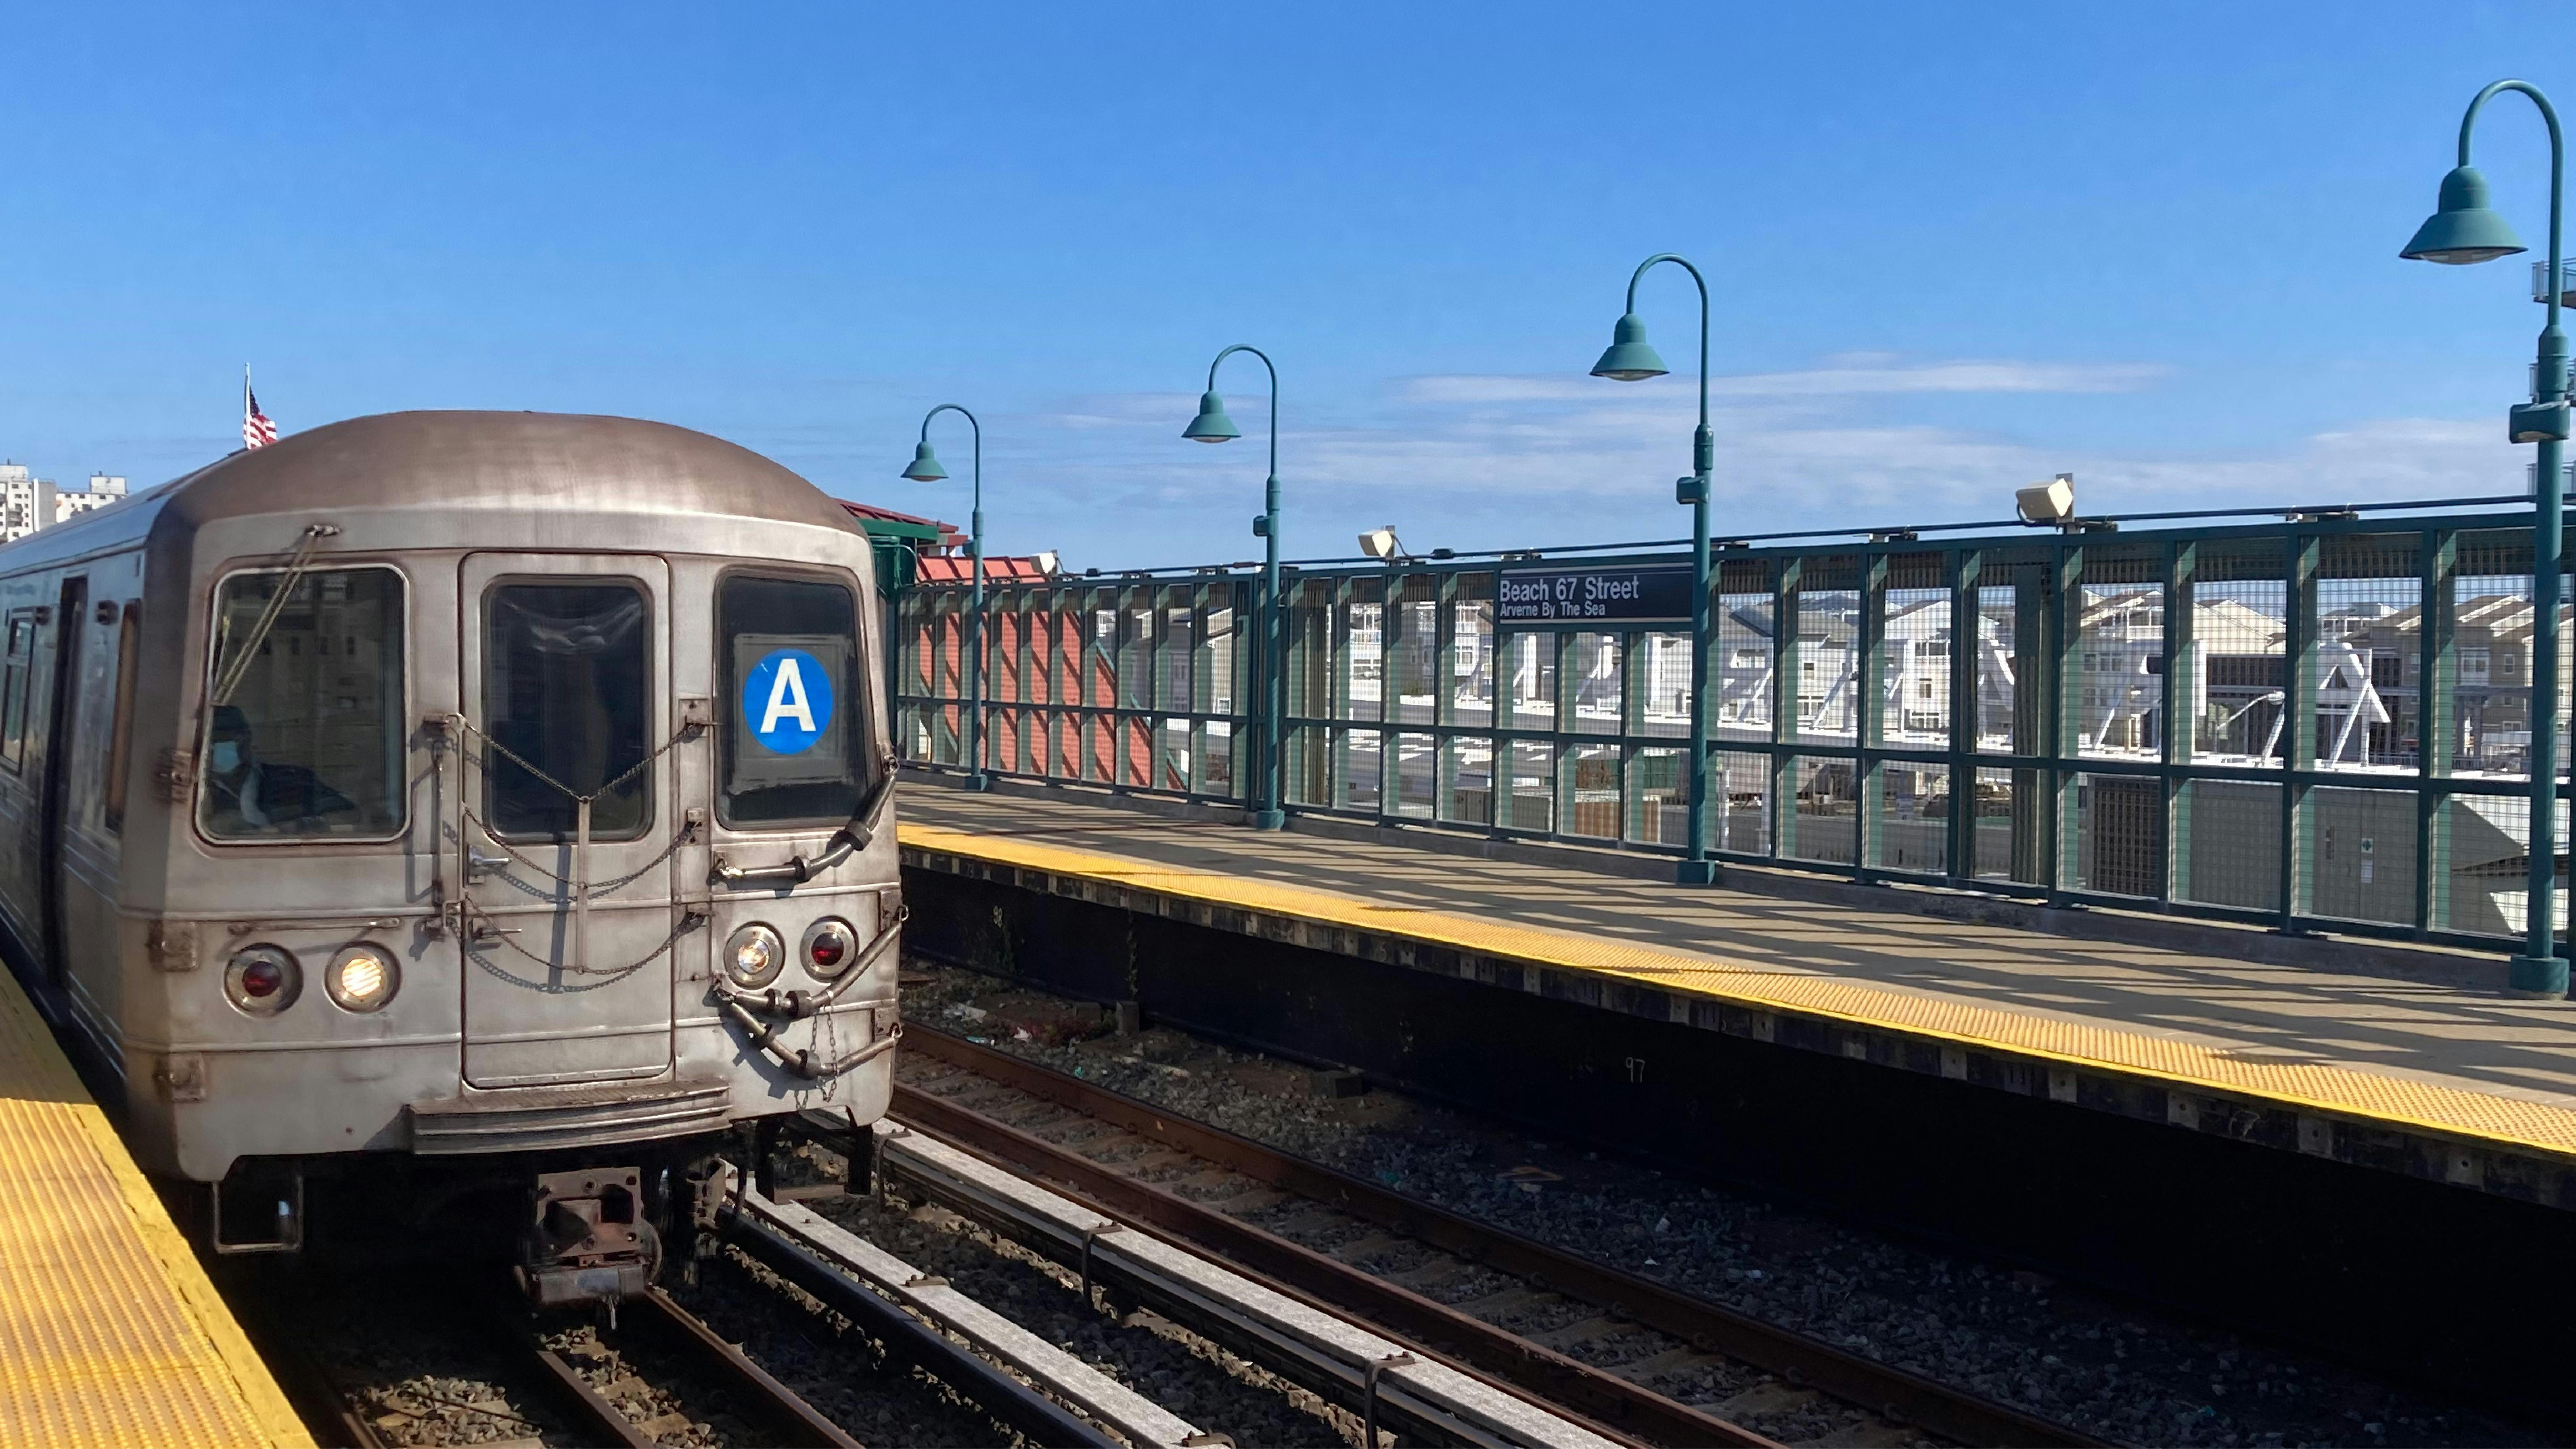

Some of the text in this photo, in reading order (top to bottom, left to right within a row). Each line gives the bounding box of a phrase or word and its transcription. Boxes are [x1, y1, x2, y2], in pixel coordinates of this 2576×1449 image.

[1500, 576, 1639, 602] Beach 67 Street
[1500, 601, 1606, 619] Arverne By The Sea
[760, 659, 816, 733] A
[1626, 1057, 1645, 1083] 97
